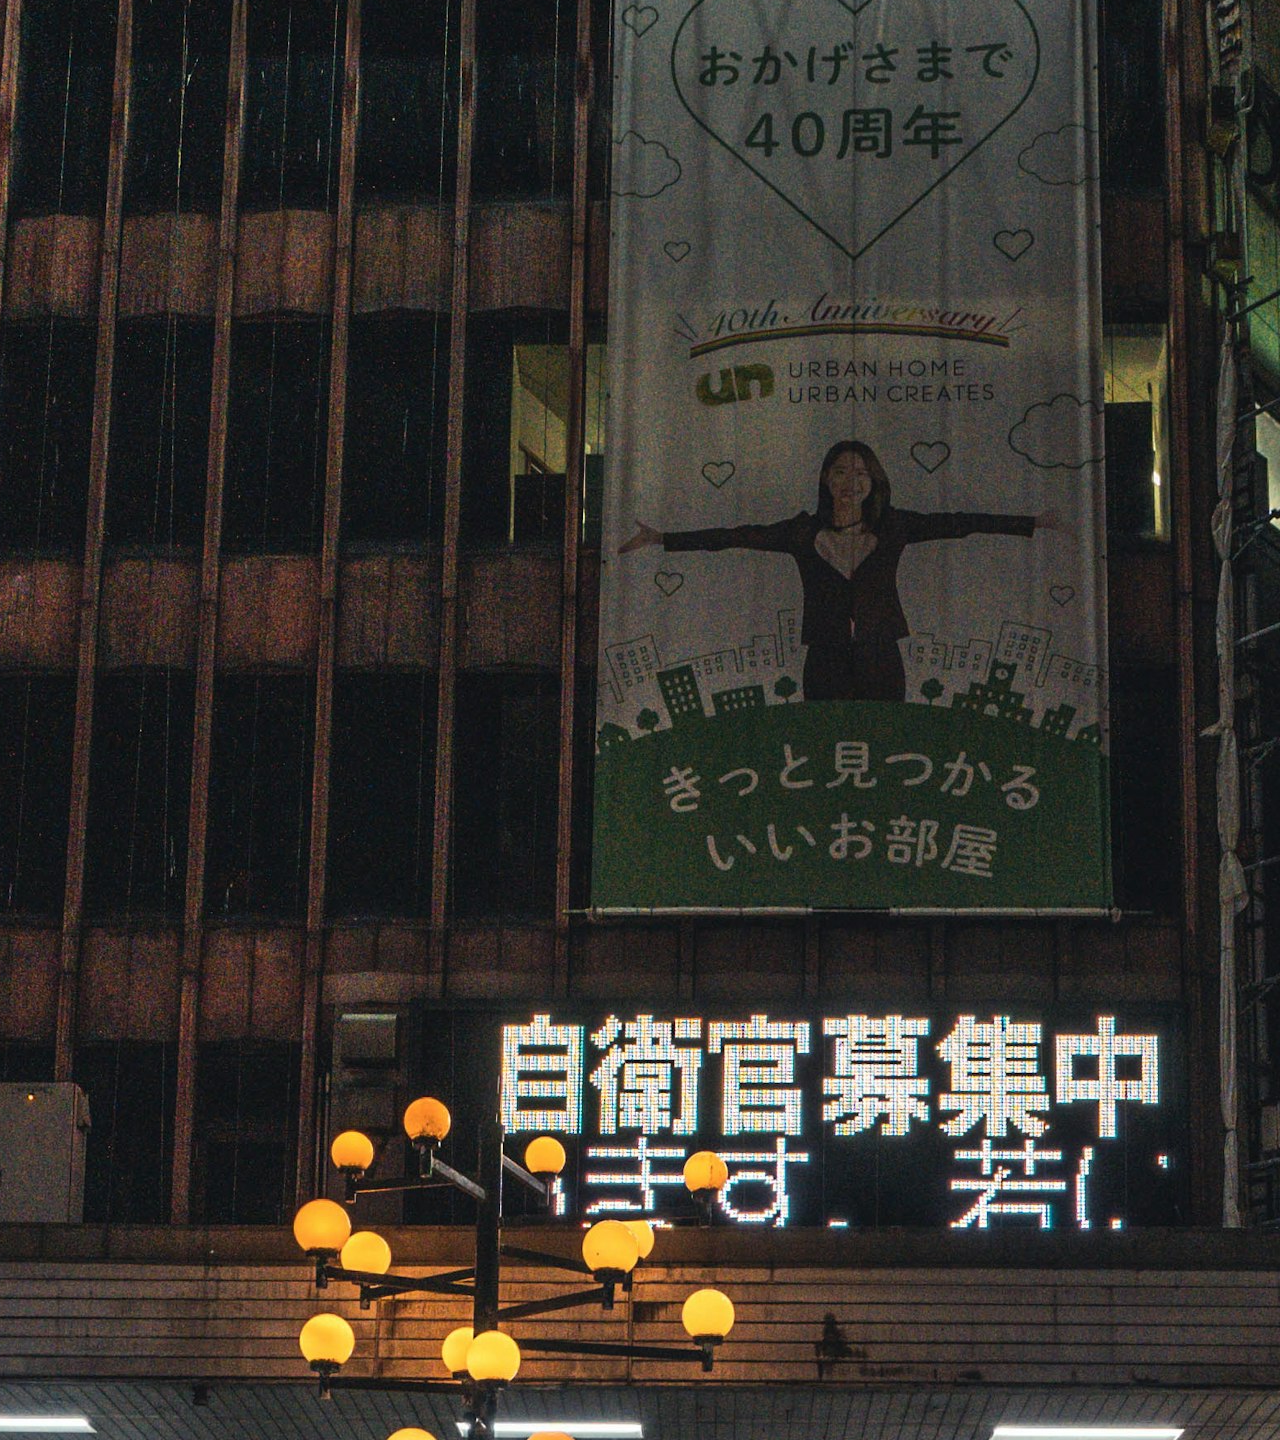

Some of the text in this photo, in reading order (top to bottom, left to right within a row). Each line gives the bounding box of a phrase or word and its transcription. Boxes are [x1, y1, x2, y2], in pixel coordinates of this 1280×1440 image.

[699, 40, 1014, 87] おかげさまで
[743, 105, 965, 162] 40周年
[707, 291, 998, 338] 40th Anniversary
[788, 359, 966, 379] URBAN HOME
[788, 383, 996, 404] URBAN CREATES
[661, 740, 1043, 814] きっと見つかる
[704, 813, 1000, 881] いいお部屋
[500, 1012, 1162, 1139] 自衛官募集中
